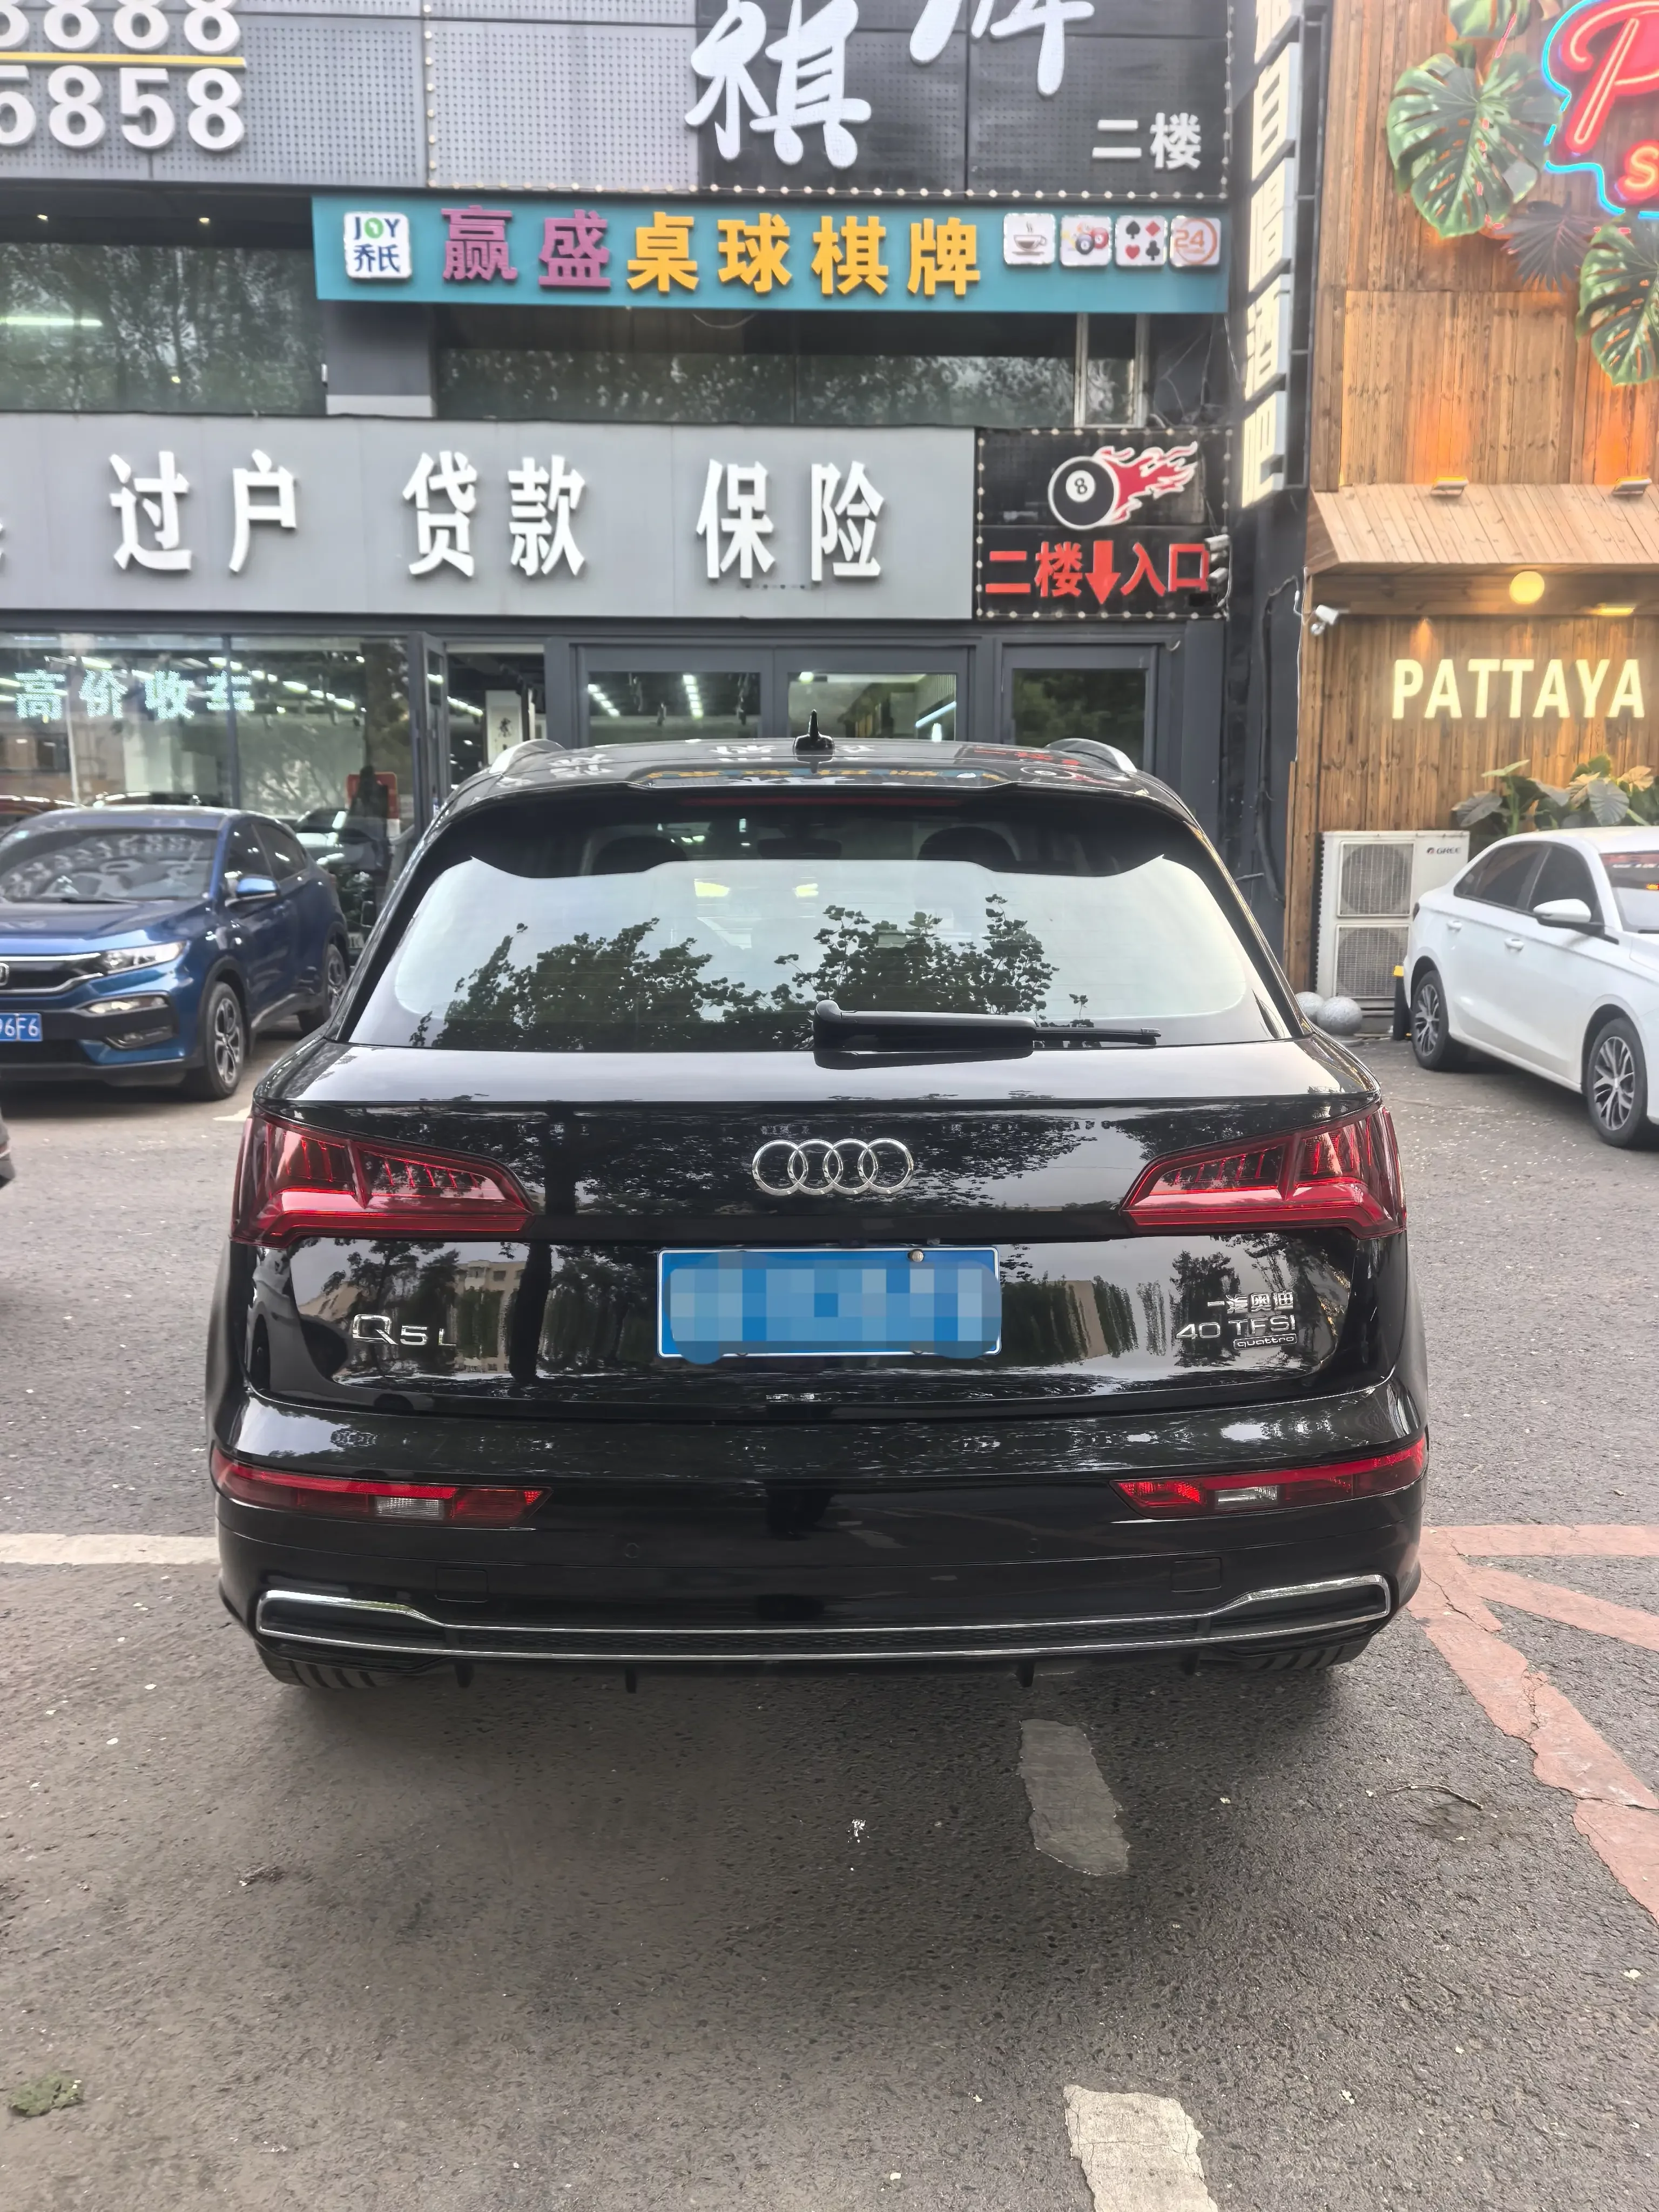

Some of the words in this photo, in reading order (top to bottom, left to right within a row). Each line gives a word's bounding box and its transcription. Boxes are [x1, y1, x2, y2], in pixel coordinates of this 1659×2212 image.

[0, 65, 245, 151] 5858
[1091, 112, 1202, 170] 二楼
[354, 217, 400, 239] JOY
[354, 245, 401, 273] 乔氏
[110, 449, 297, 573] 过户
[402, 451, 585, 577] 贷款
[696, 458, 885, 581] 保险
[985, 541, 1083, 598] 二楼
[1120, 542, 1210, 597] 入口
[15, 669, 255, 719] 高价收车
[1391, 658, 1645, 720] PATTAYA
[1176, 1321, 1220, 1340] 40
[1228, 1314, 1296, 1336] TFSI
[1237, 1335, 1294, 1348] quattro
